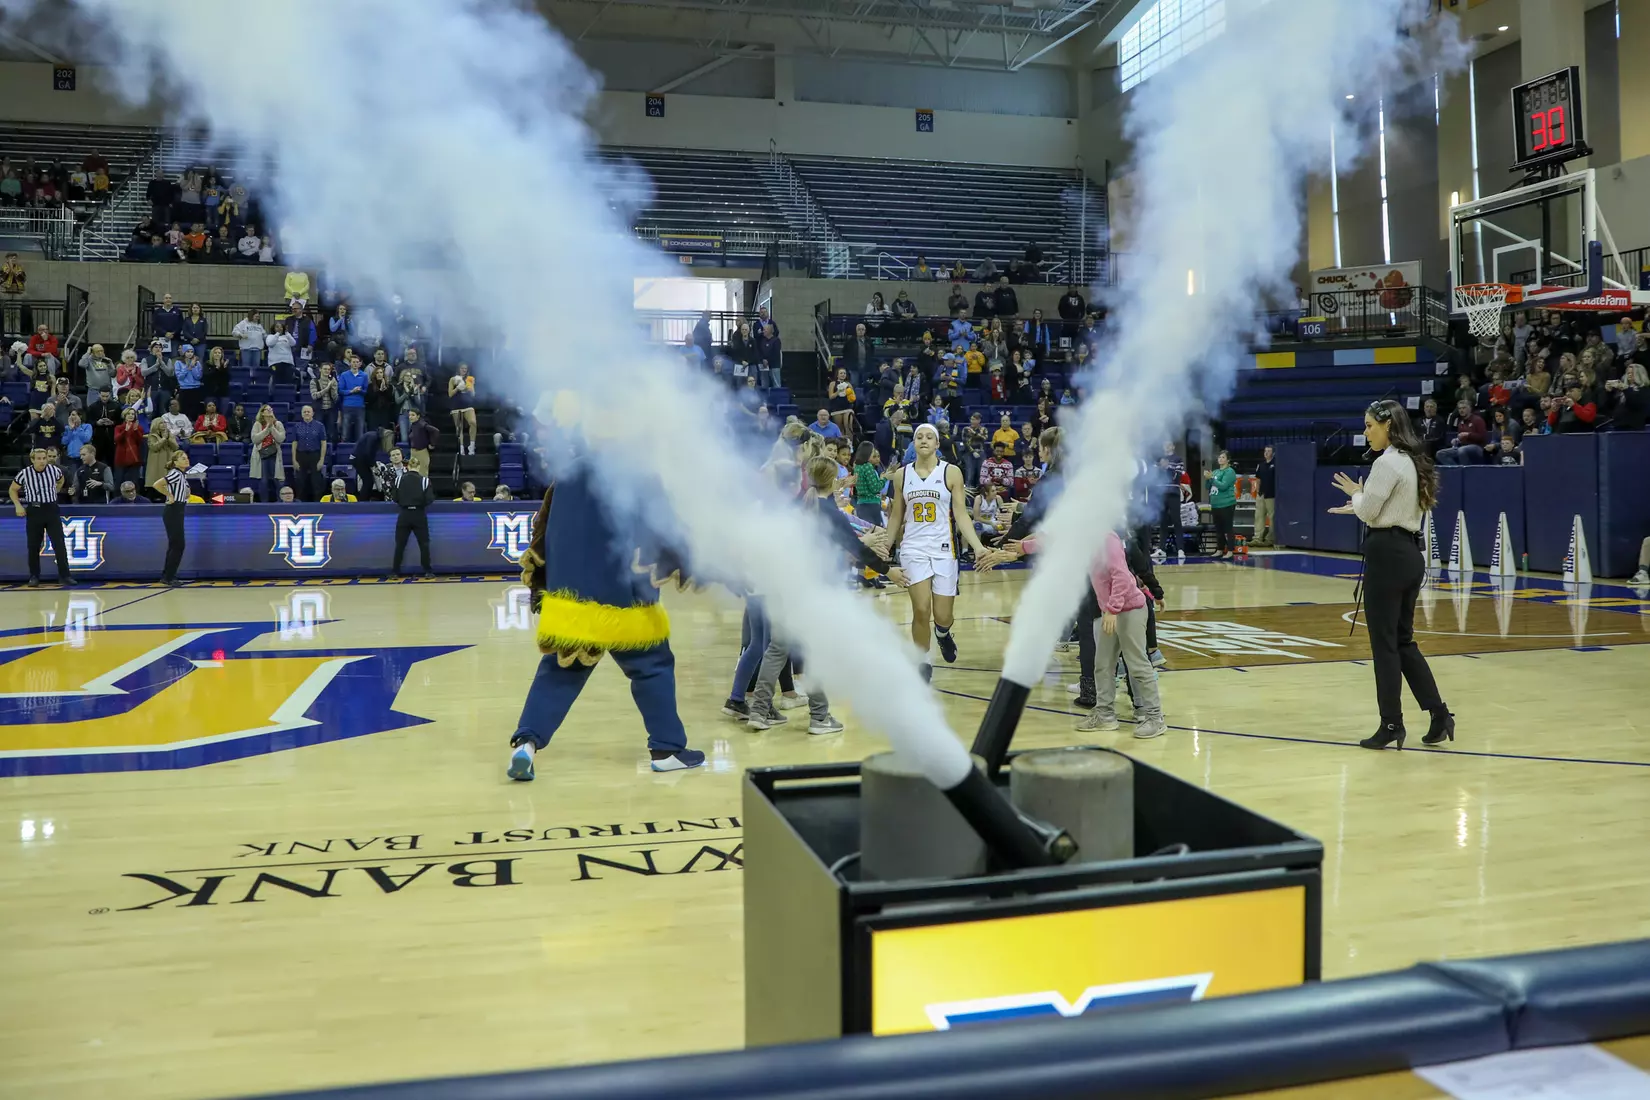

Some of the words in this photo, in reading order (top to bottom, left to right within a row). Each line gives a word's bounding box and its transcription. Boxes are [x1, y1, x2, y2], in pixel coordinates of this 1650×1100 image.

[56, 69, 73, 78] 202
[58, 80, 71, 89] GA
[648, 97, 662, 106] 204
[649, 107, 660, 116] GA
[918, 113, 931, 122] 205
[919, 123, 930, 131] GA
[1530, 105, 1566, 151] 30
[1317, 274, 1349, 285] CHUCK
[1303, 323, 1321, 335] 106
[908, 489, 940, 501] MARQUETTE
[912, 501, 937, 523] 23
[270, 515, 333, 568] MU
[232, 834, 425, 858] BANK
[116, 857, 523, 911] BANK
